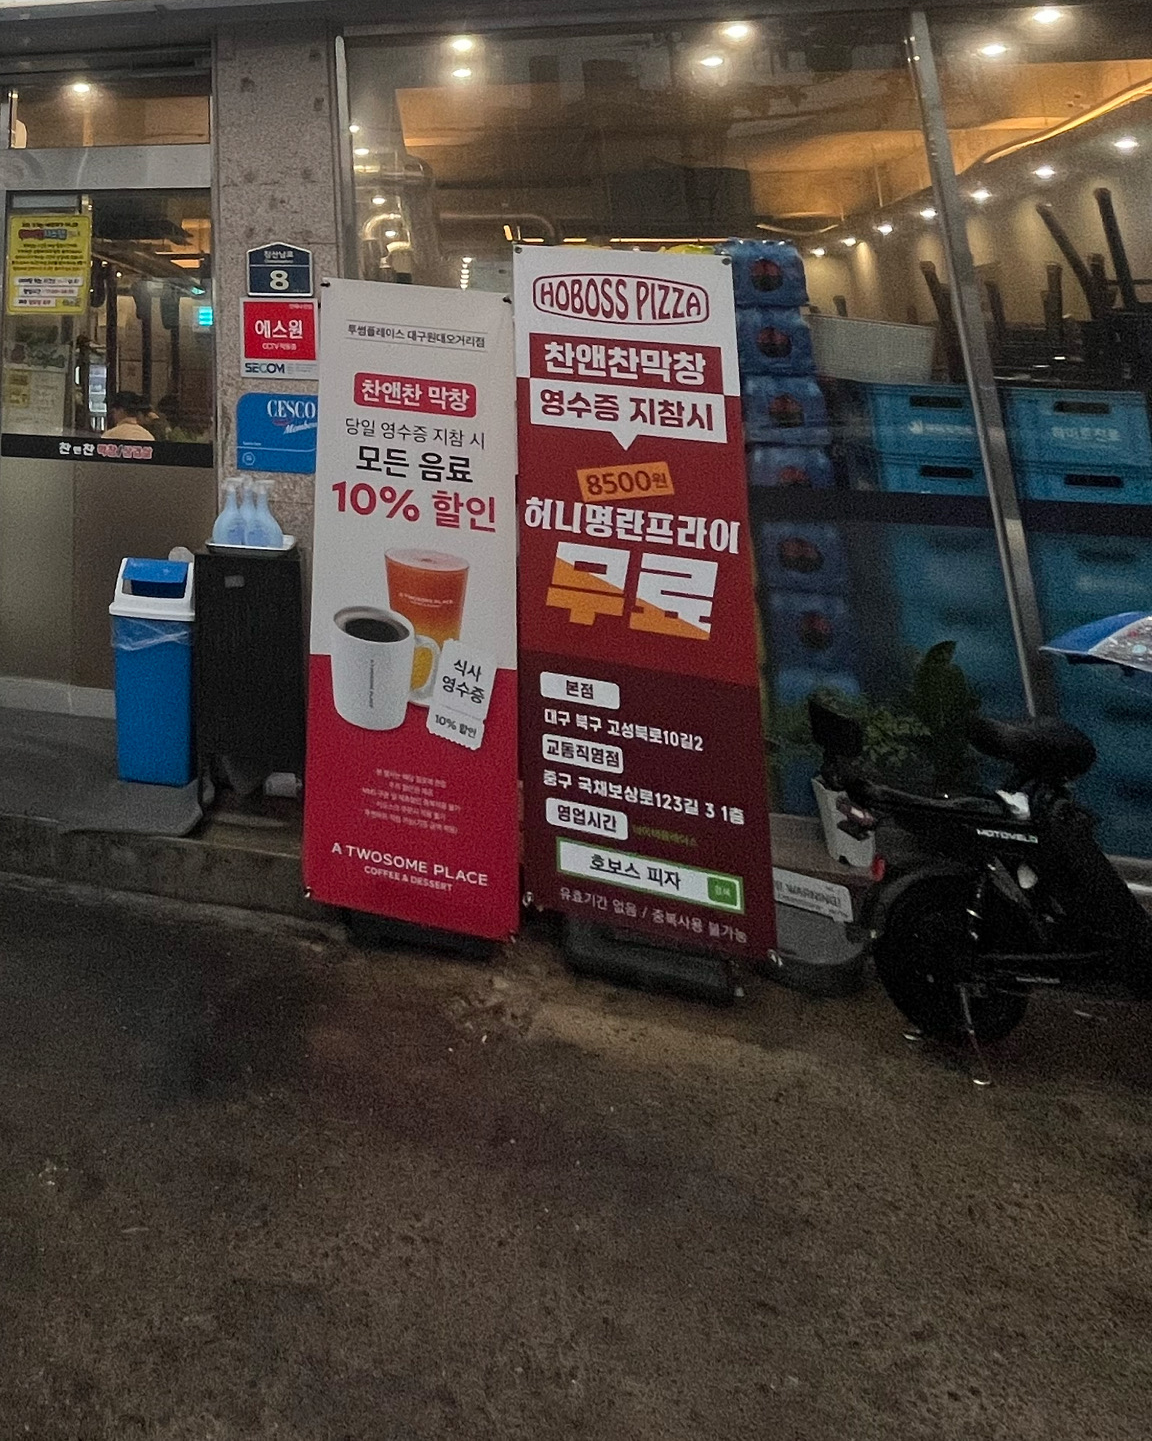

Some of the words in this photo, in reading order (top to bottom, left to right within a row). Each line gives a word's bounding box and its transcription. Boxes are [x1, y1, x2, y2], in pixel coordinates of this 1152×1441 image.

[270, 270, 289, 290] 8
[540, 280, 629, 320] HOBOSS
[636, 284, 702, 320] PIZZA
[255, 319, 303, 339] 에스원
[348, 324, 405, 339] 투썸플레이스
[245, 362, 285, 374] SECOM
[544, 340, 707, 386] 찬앤찬막창
[267, 399, 316, 418] CESCO
[361, 379, 422, 407] 찬앤찬
[428, 386, 470, 412] 막창
[540, 389, 620, 422] 영수증
[629, 396, 714, 431] 지참시
[345, 417, 375, 437] 당일
[381, 422, 428, 443] 영수증
[433, 428, 464, 448] 지참
[470, 432, 485, 449] 시
[356, 445, 409, 478] 모든
[418, 452, 473, 483] 음료
[586, 469, 669, 496] 8500원
[332, 480, 420, 522] 10%
[432, 489, 496, 532] 할인
[524, 496, 741, 555] 허니명란프라이
[545, 540, 718, 641] 무료
[453, 659, 482, 682] 식사
[442, 675, 485, 704] 영수증
[565, 679, 594, 700] 본점
[435, 714, 457, 730] 10%
[459, 723, 477, 739] 할인
[544, 708, 571, 726] 대구
[576, 713, 602, 732] 북구
[546, 738, 620, 768] 교동직영점
[543, 769, 572, 789] 중구
[578, 776, 699, 816] 국채보상로123길
[705, 802, 715, 819] 3
[720, 805, 745, 825] 1층
[557, 804, 617, 833] 영업시간
[331, 842, 342, 855] A
[346, 844, 428, 874] TWOSOME
[433, 863, 488, 886] PLACE
[364, 865, 400, 881] COFFEE
[410, 875, 453, 891] DESSERT
[590, 853, 641, 879] 호보스
[647, 866, 681, 891] 피자
[560, 886, 608, 911] 유효기간
[613, 899, 637, 917] 없음
[651, 909, 703, 933] 중복사용
[708, 921, 747, 943] 불가능
